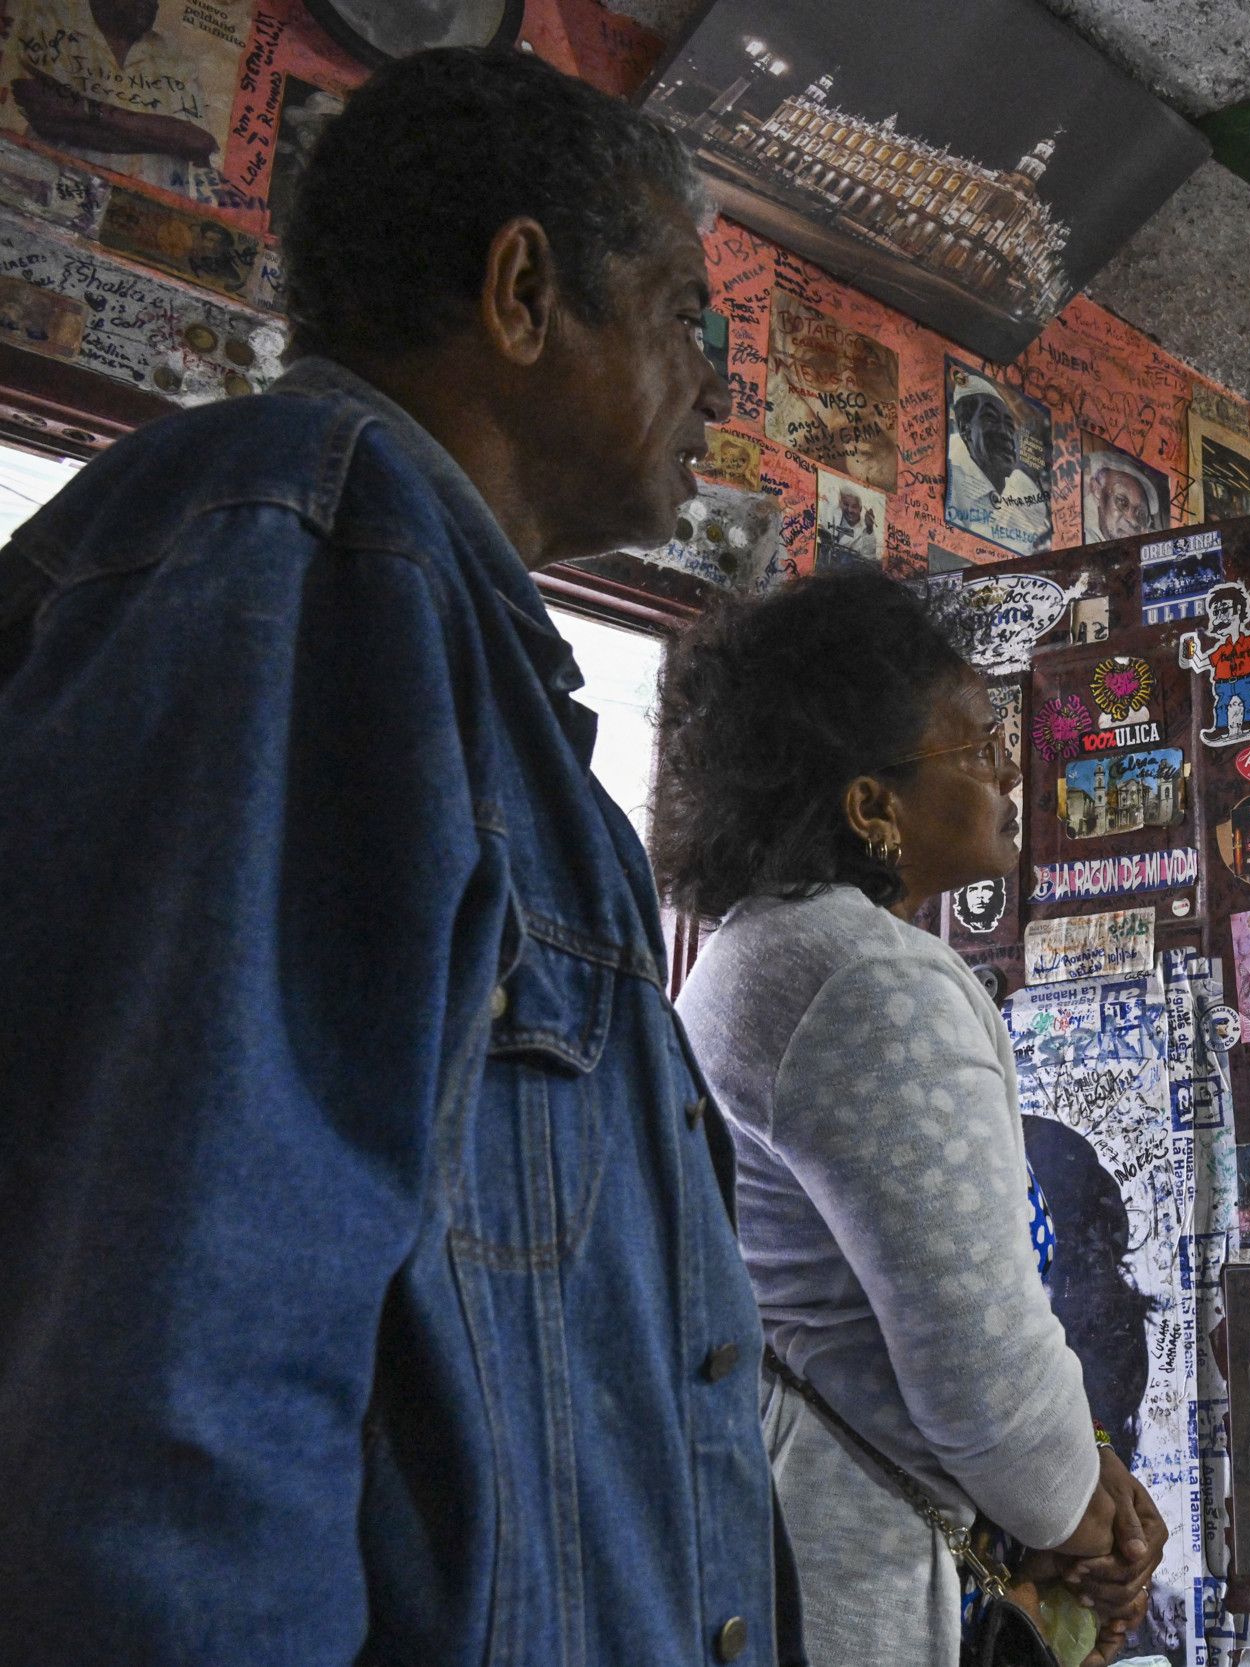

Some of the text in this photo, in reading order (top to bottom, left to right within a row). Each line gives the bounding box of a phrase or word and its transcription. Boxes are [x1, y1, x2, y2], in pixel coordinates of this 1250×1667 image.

[818, 391, 867, 411] VASCO
[1055, 863, 1070, 900] LA
[1073, 857, 1119, 897] RAZON
[1118, 854, 1142, 891] DE
[1145, 851, 1161, 889] MI
[1030, 985, 1097, 1003] La Habana
[1174, 987, 1186, 1032] Aguas
[1172, 1137, 1183, 1155] La
[1189, 1465, 1201, 1554] La Habana
[1195, 1645, 1205, 1667] La
